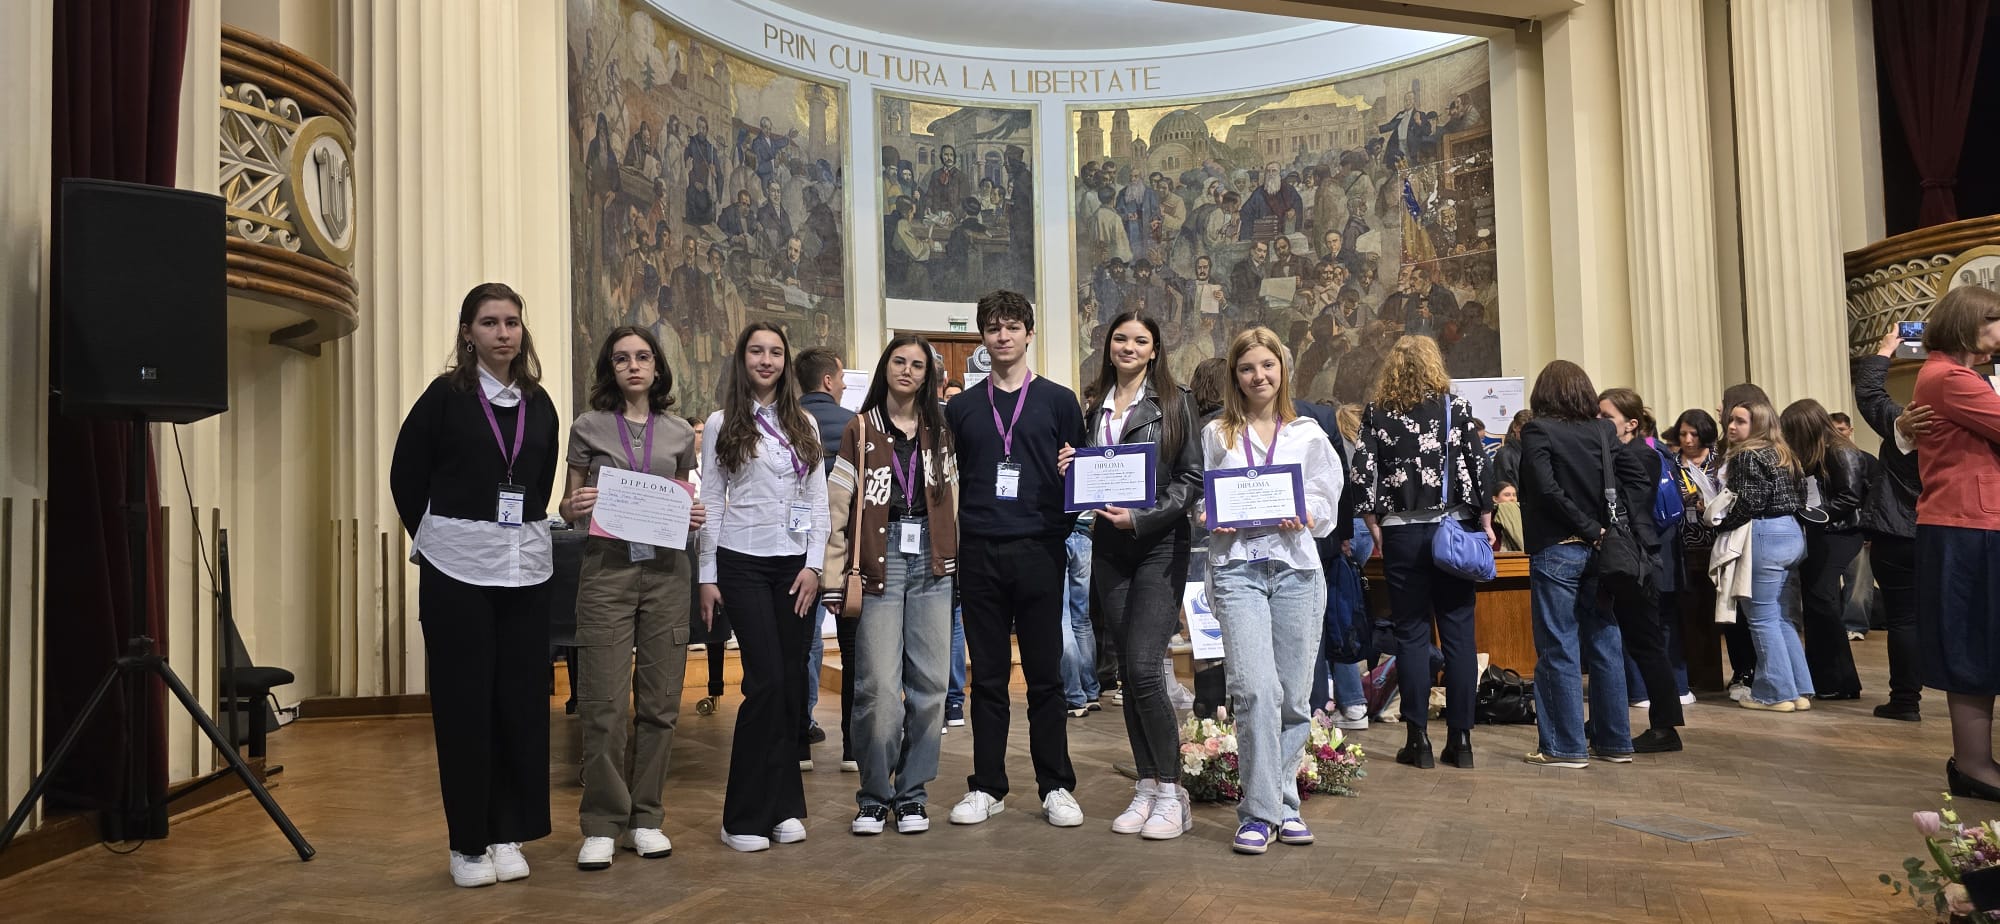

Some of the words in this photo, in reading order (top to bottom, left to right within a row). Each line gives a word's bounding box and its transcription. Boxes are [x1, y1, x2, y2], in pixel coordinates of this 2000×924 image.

[763, 22, 816, 63] PRIN
[829, 44, 948, 87] CULTURA
[962, 65, 997, 92] LA
[1010, 66, 1161, 94] LIBERTATE
